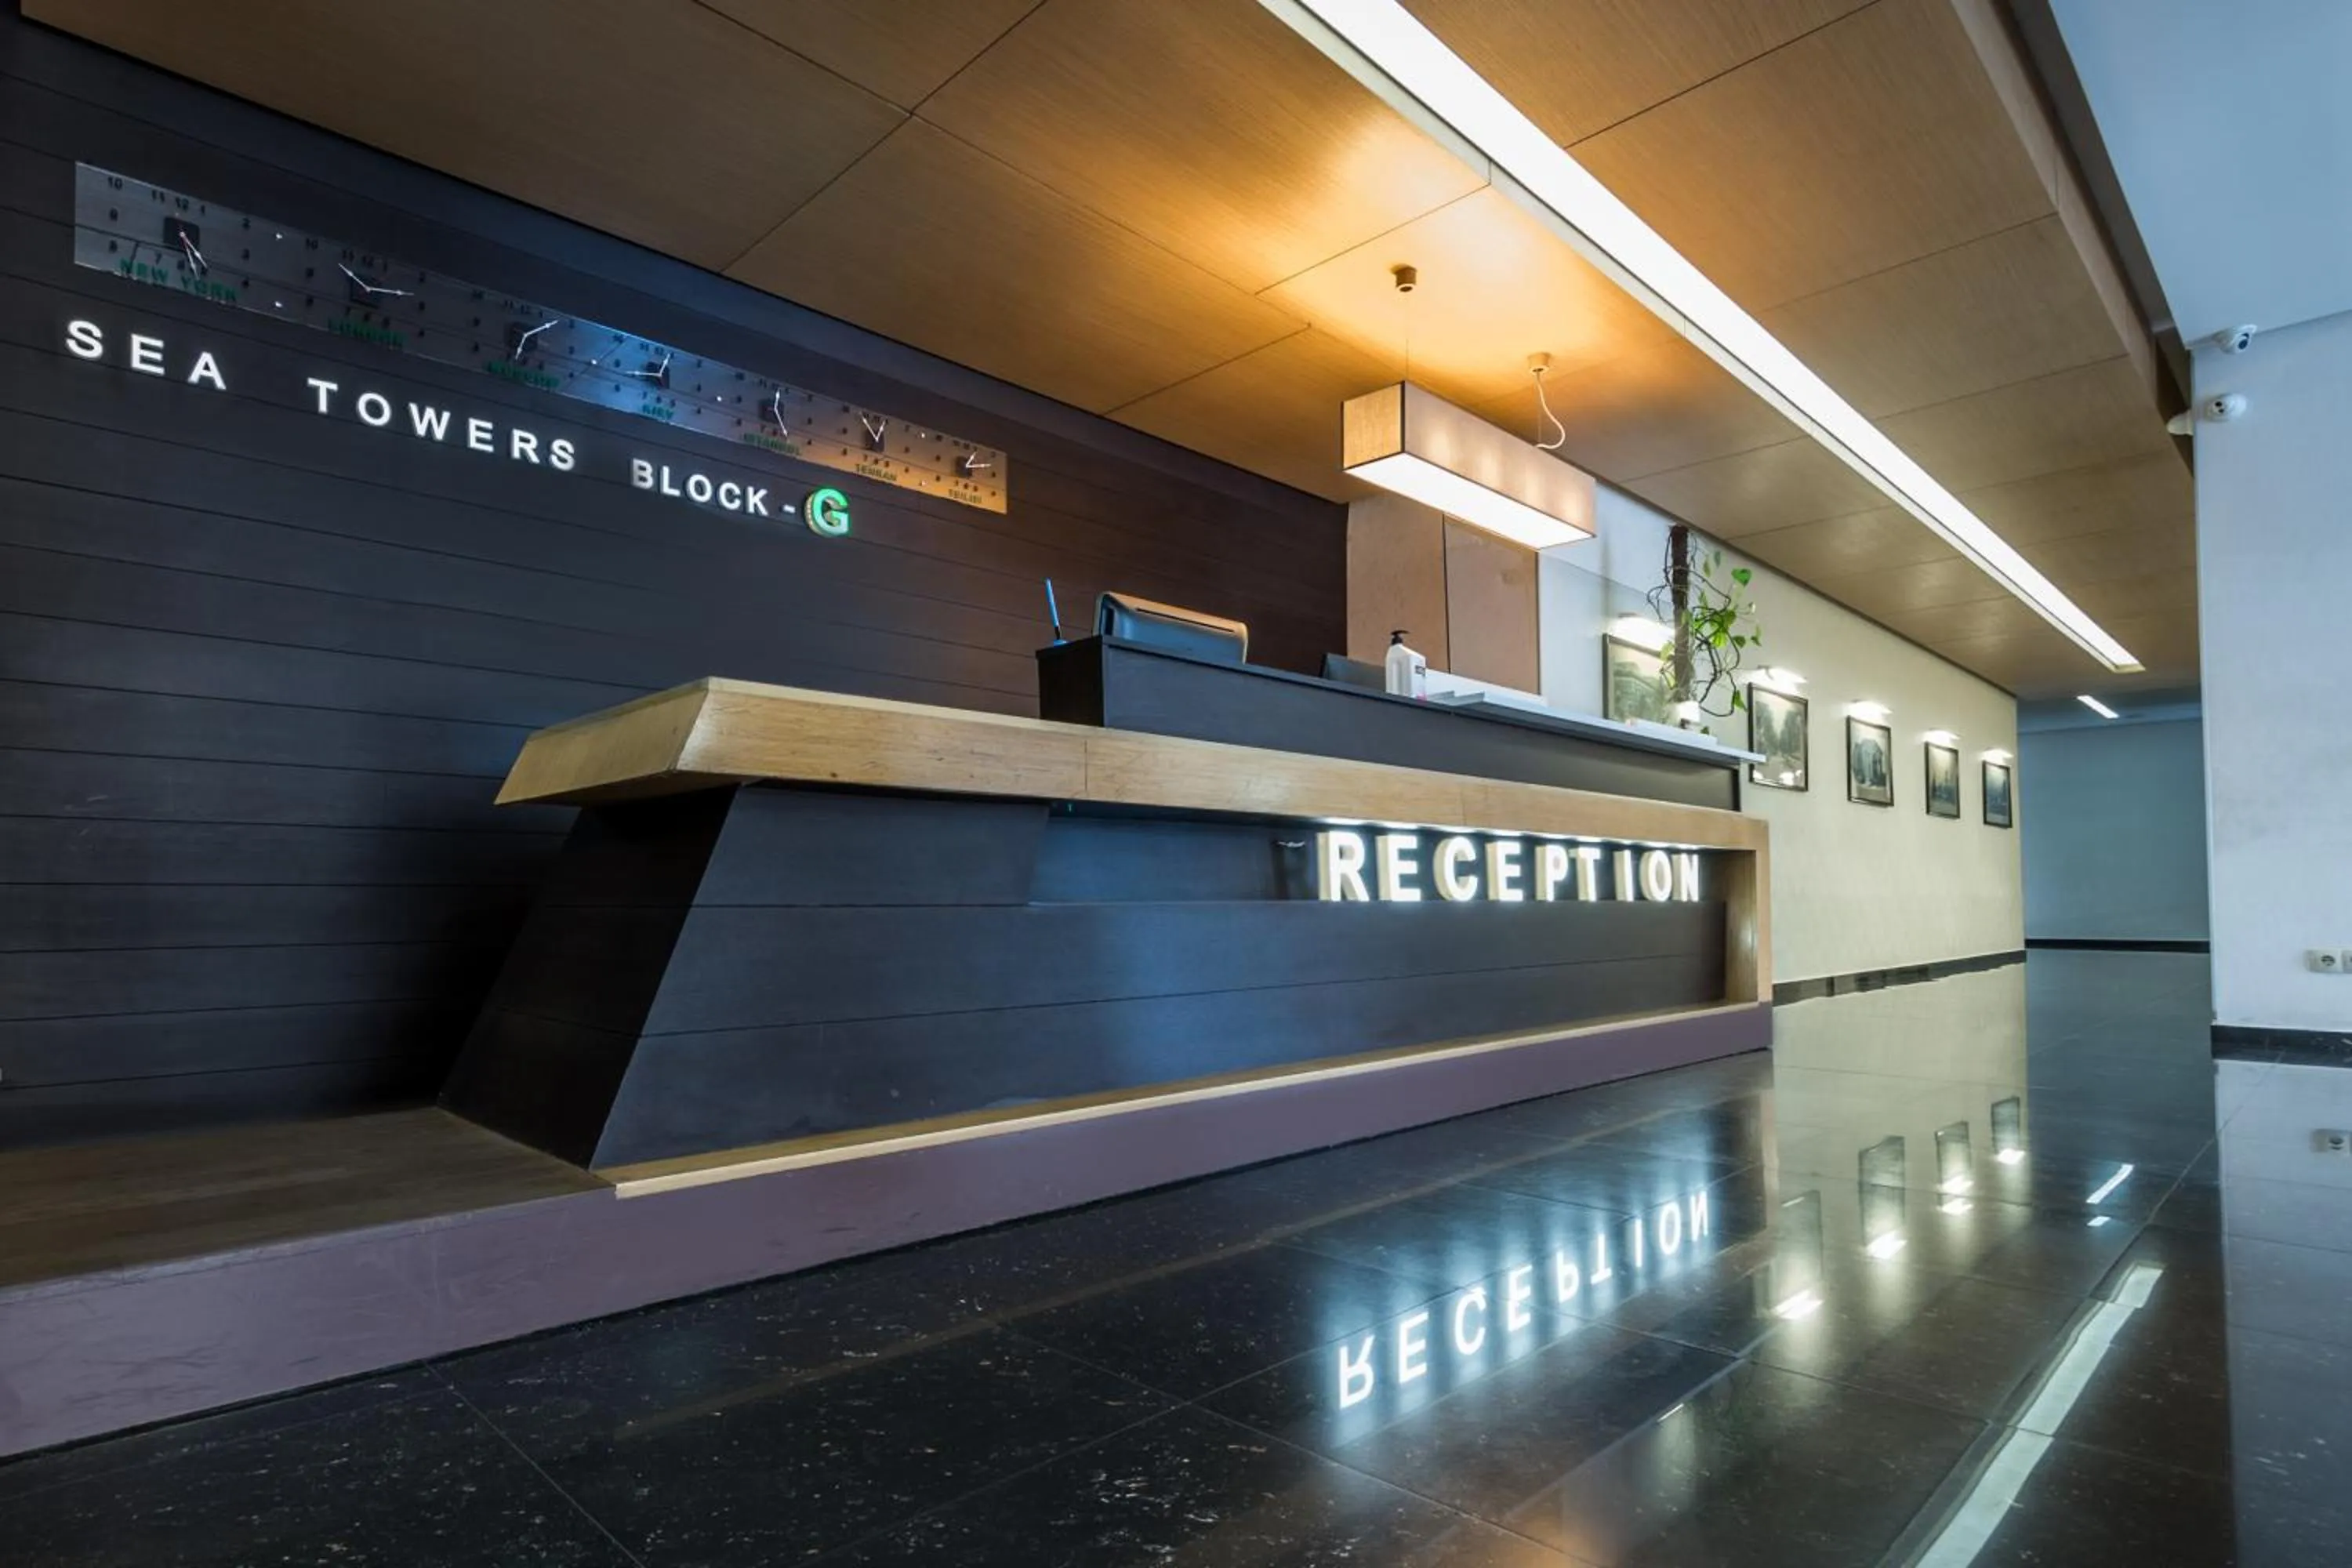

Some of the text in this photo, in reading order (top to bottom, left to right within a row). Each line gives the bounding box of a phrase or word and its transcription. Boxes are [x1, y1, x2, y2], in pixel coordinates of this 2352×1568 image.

[107, 175, 123, 191] 10
[120, 257, 169, 284] NEW
[180, 276, 237, 303] YORK
[66, 319, 227, 390] SEA
[307, 377, 576, 471] TOWERS
[1317, 830, 1700, 902] RECEPTION
